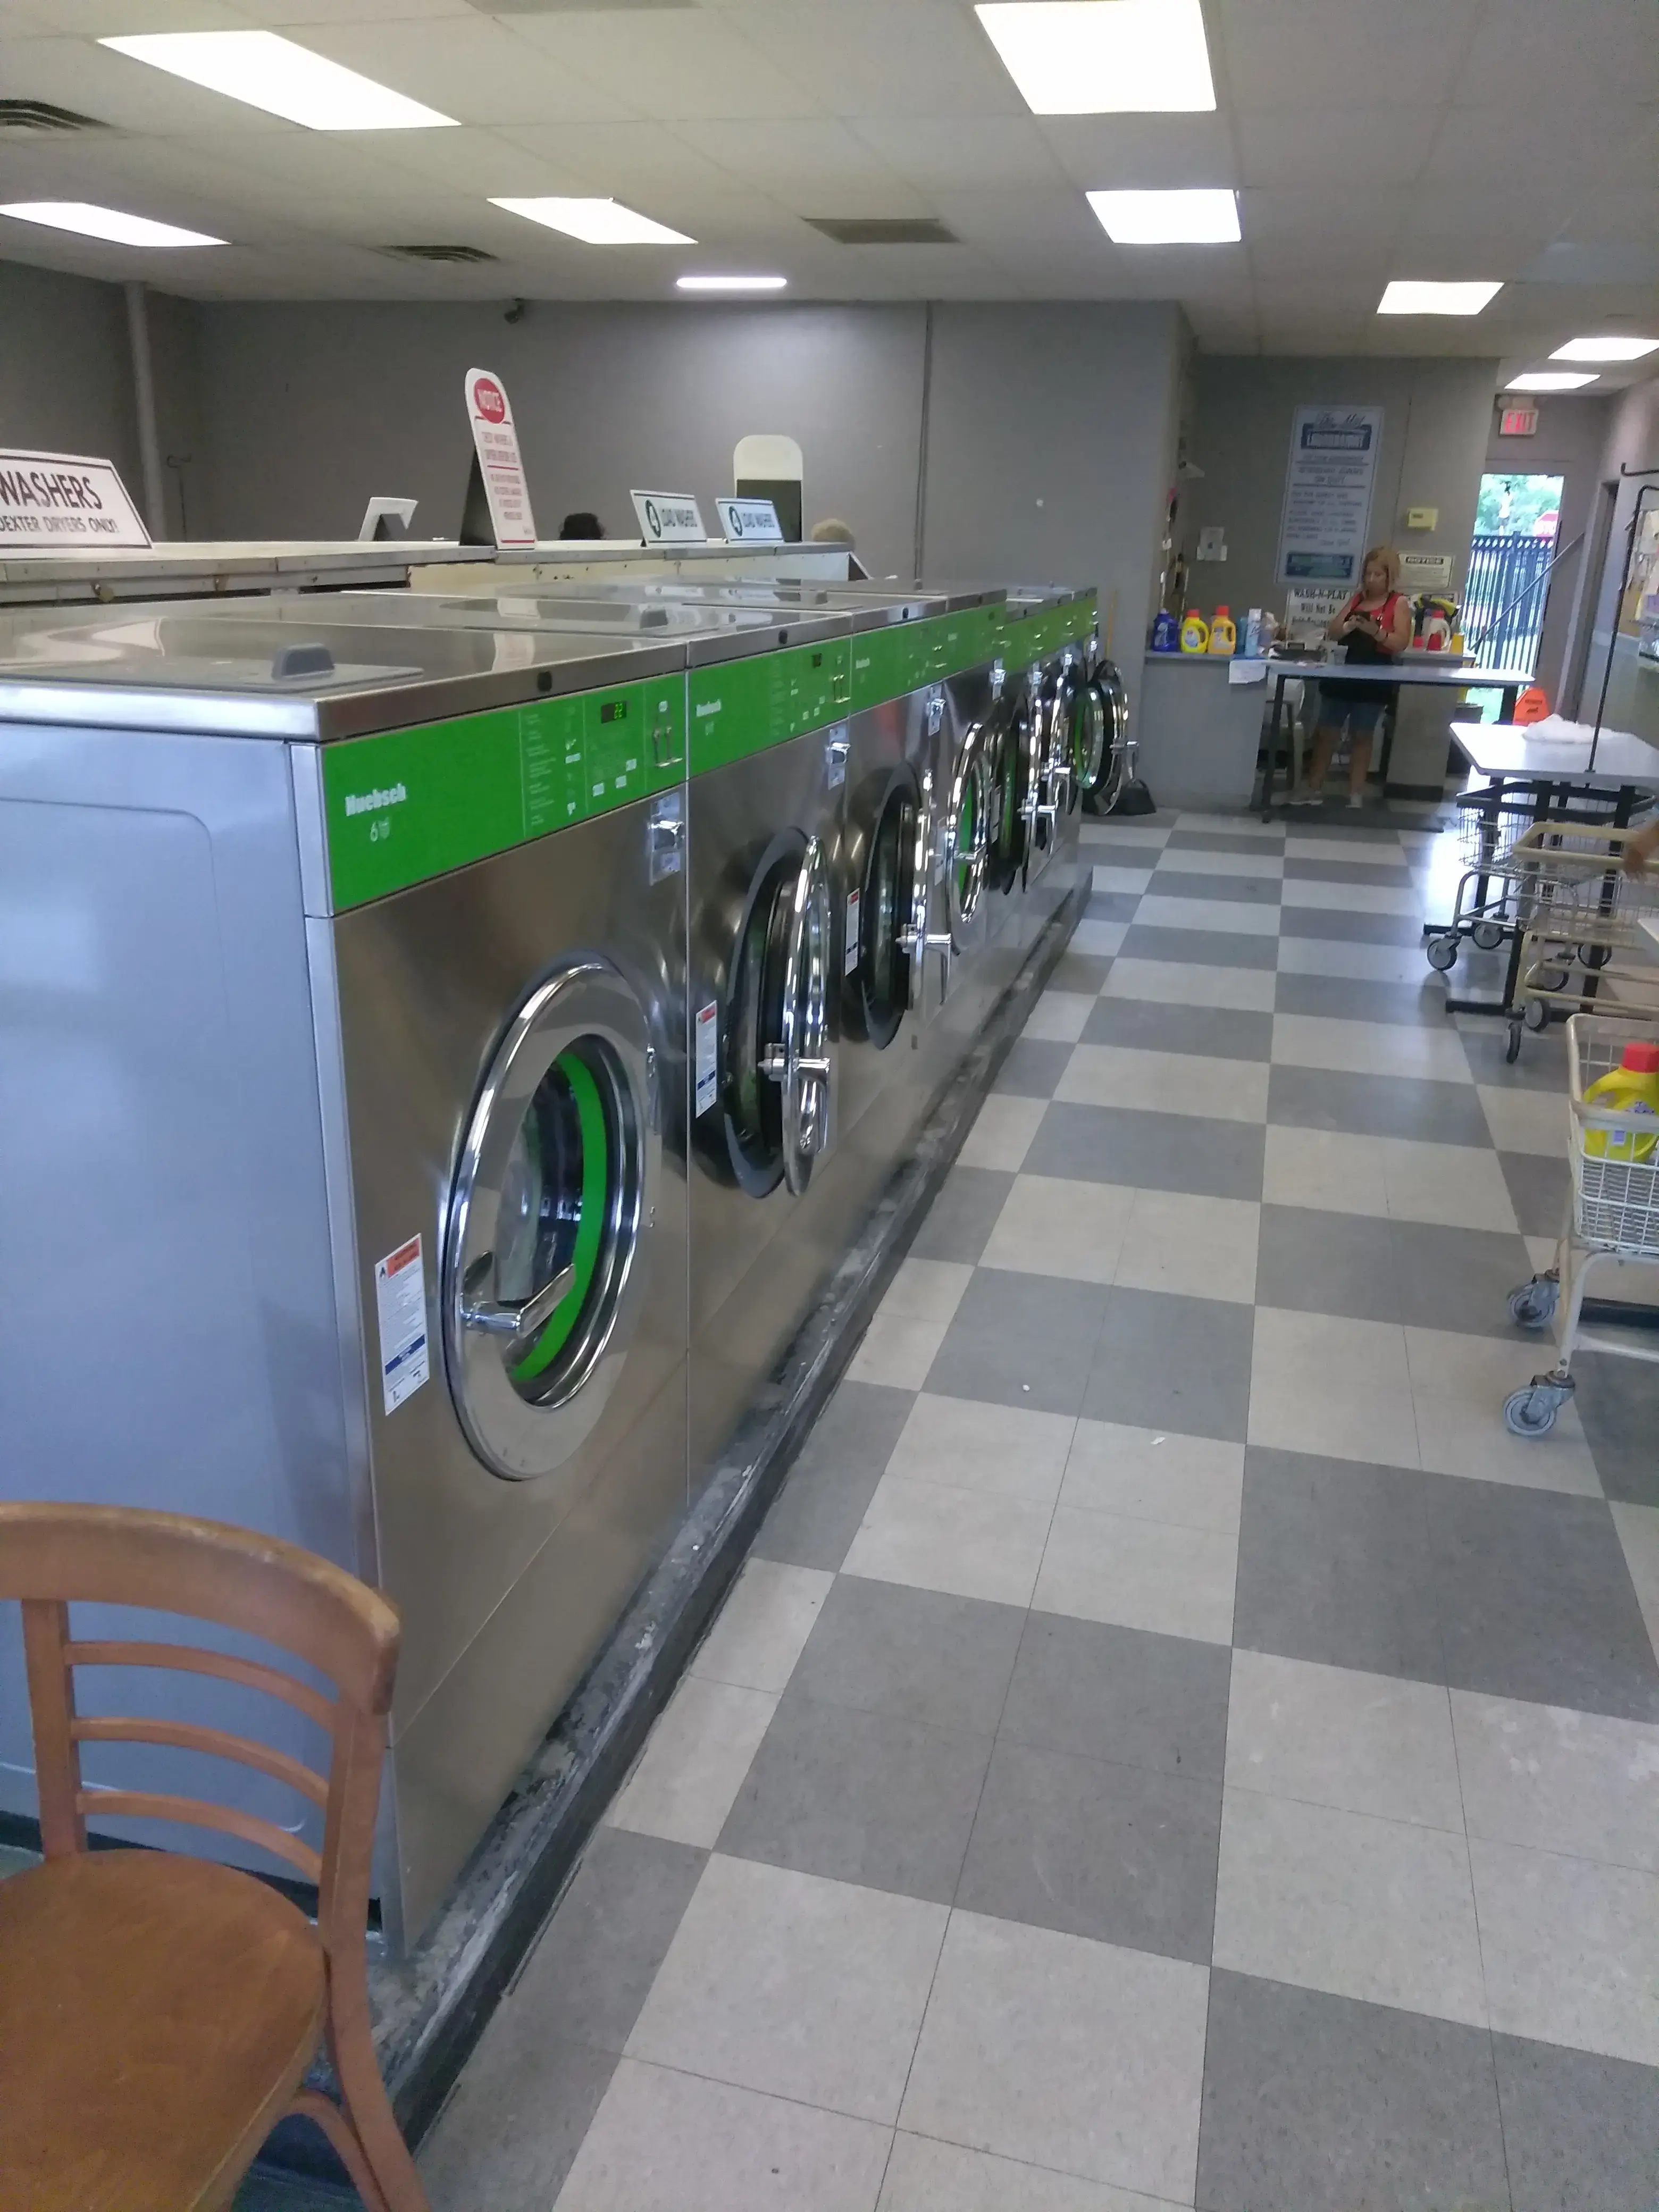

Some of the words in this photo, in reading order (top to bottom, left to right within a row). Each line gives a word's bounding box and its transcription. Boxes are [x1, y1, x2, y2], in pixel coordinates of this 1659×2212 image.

[1505, 412, 1536, 433] EXIT
[0, 471, 103, 510] WASHERS
[43, 516, 86, 533] DRYERS
[345, 783, 406, 817] Huebsch
